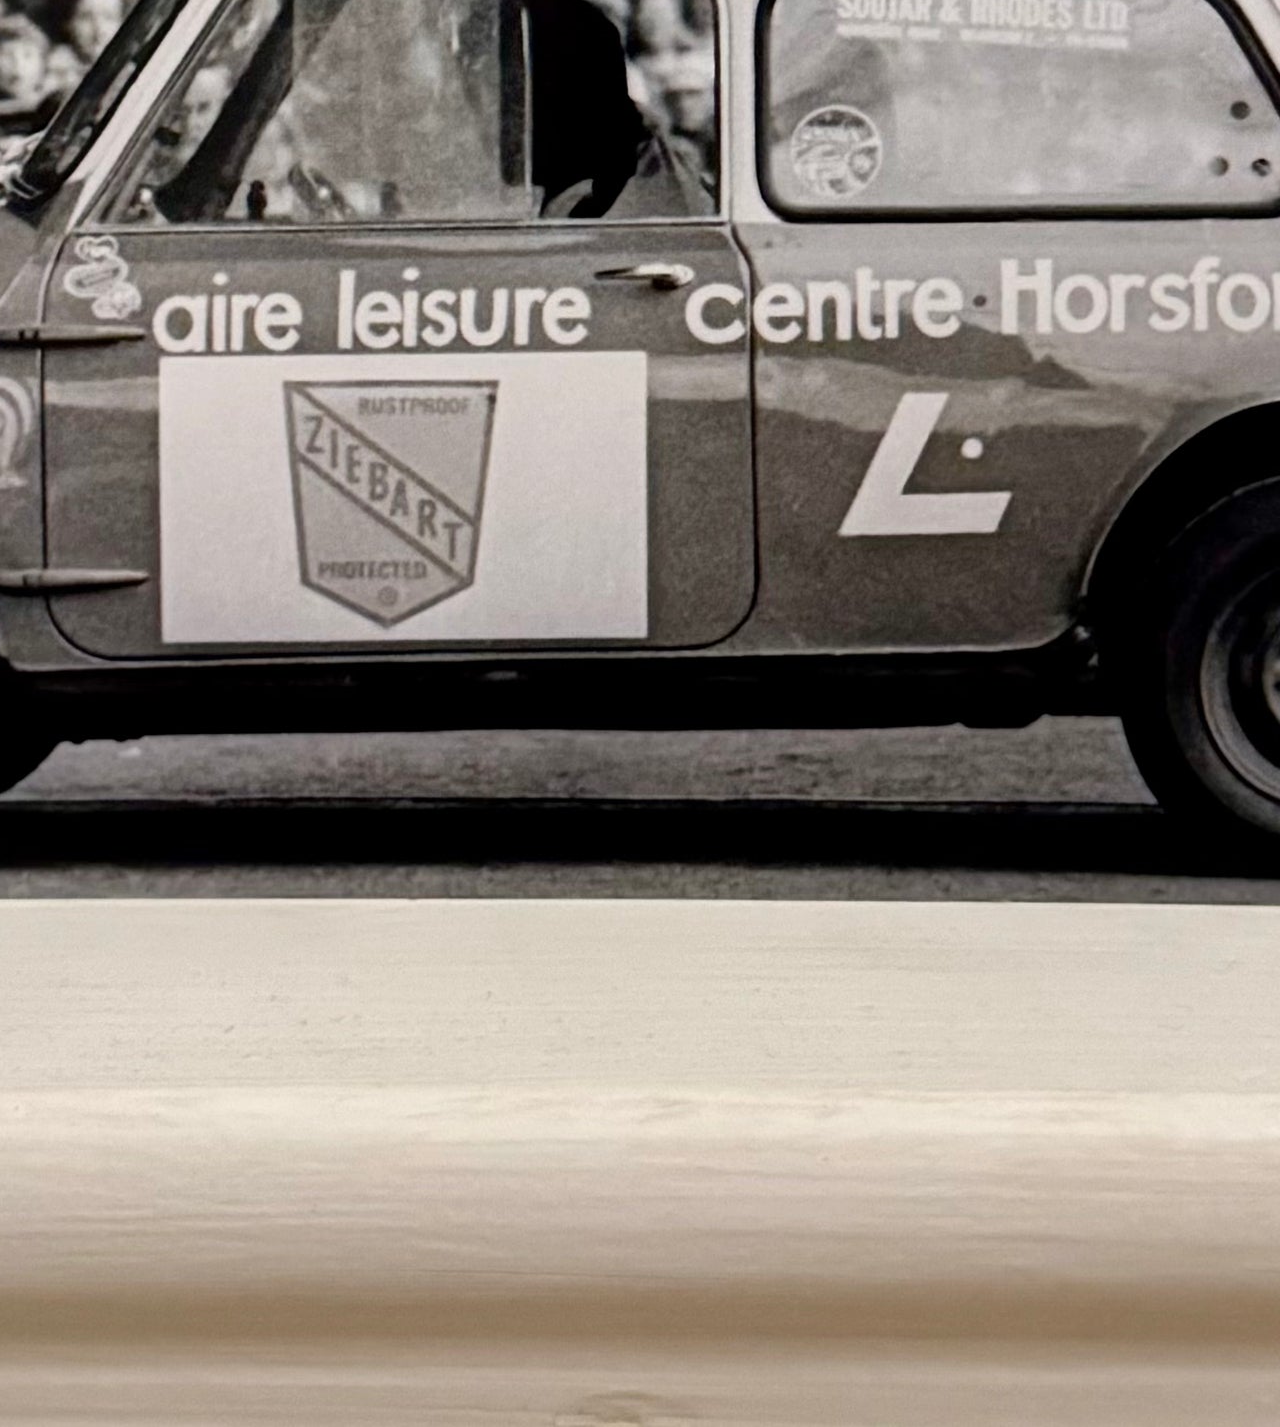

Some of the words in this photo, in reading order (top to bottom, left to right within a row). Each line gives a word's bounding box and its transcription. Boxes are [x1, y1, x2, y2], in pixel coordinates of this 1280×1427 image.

[151, 272, 304, 353] aire
[336, 266, 593, 351] leisure
[684, 267, 963, 344] centre
[357, 395, 471, 416] RUSTPROOF
[302, 415, 464, 561] ZIEBART
[317, 559, 429, 580] PROTECTED
